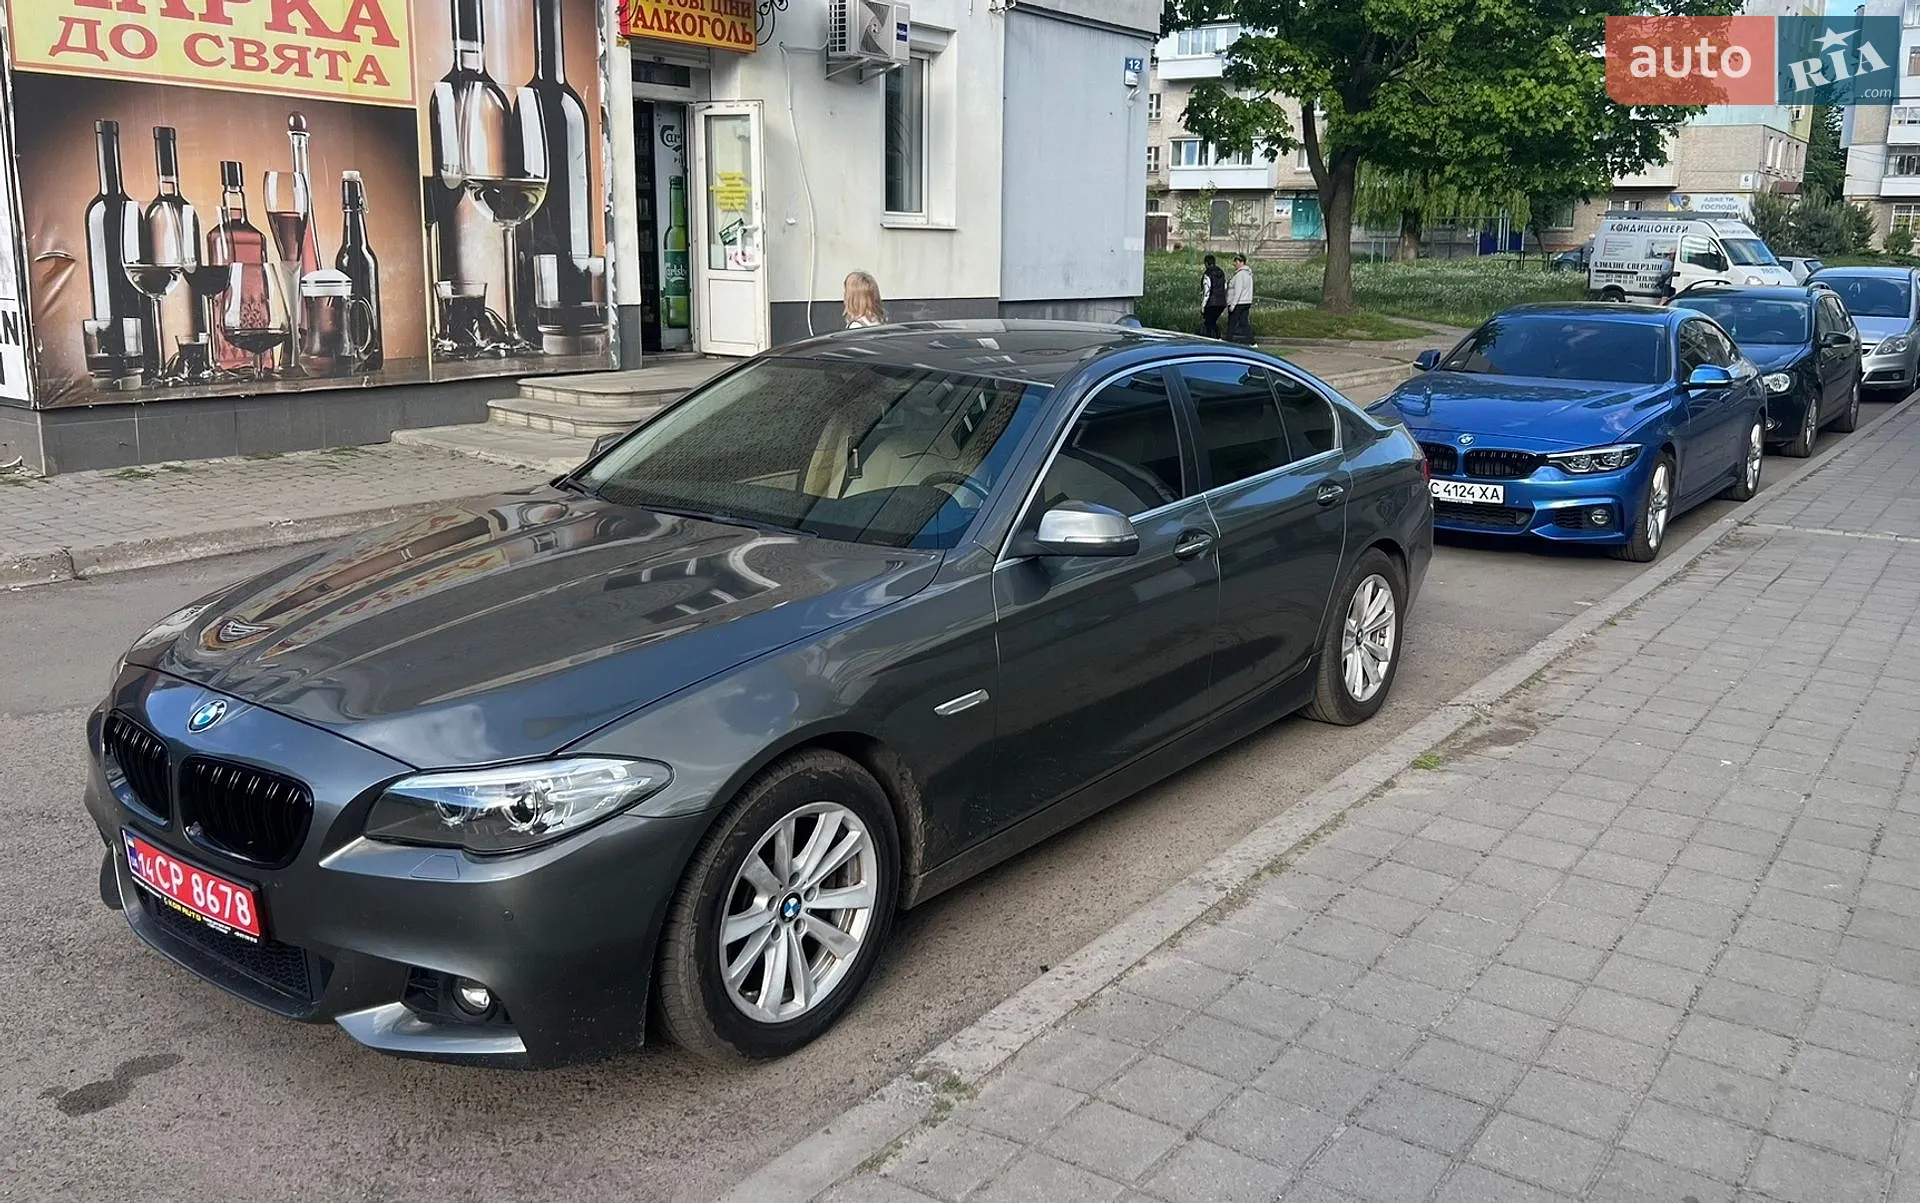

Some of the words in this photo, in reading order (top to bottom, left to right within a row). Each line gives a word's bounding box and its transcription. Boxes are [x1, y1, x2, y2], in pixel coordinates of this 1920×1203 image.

[632, 5, 754, 46] АЛКОГОЛЬ
[48, 15, 158, 62] ДО
[183, 33, 391, 87] СВЯТА
[1128, 59, 1141, 70] 12
[1430, 482, 1440, 495] C
[1443, 483, 1475, 498] 4124
[1479, 486, 1500, 500] XA
[191, 872, 252, 927] 8678
